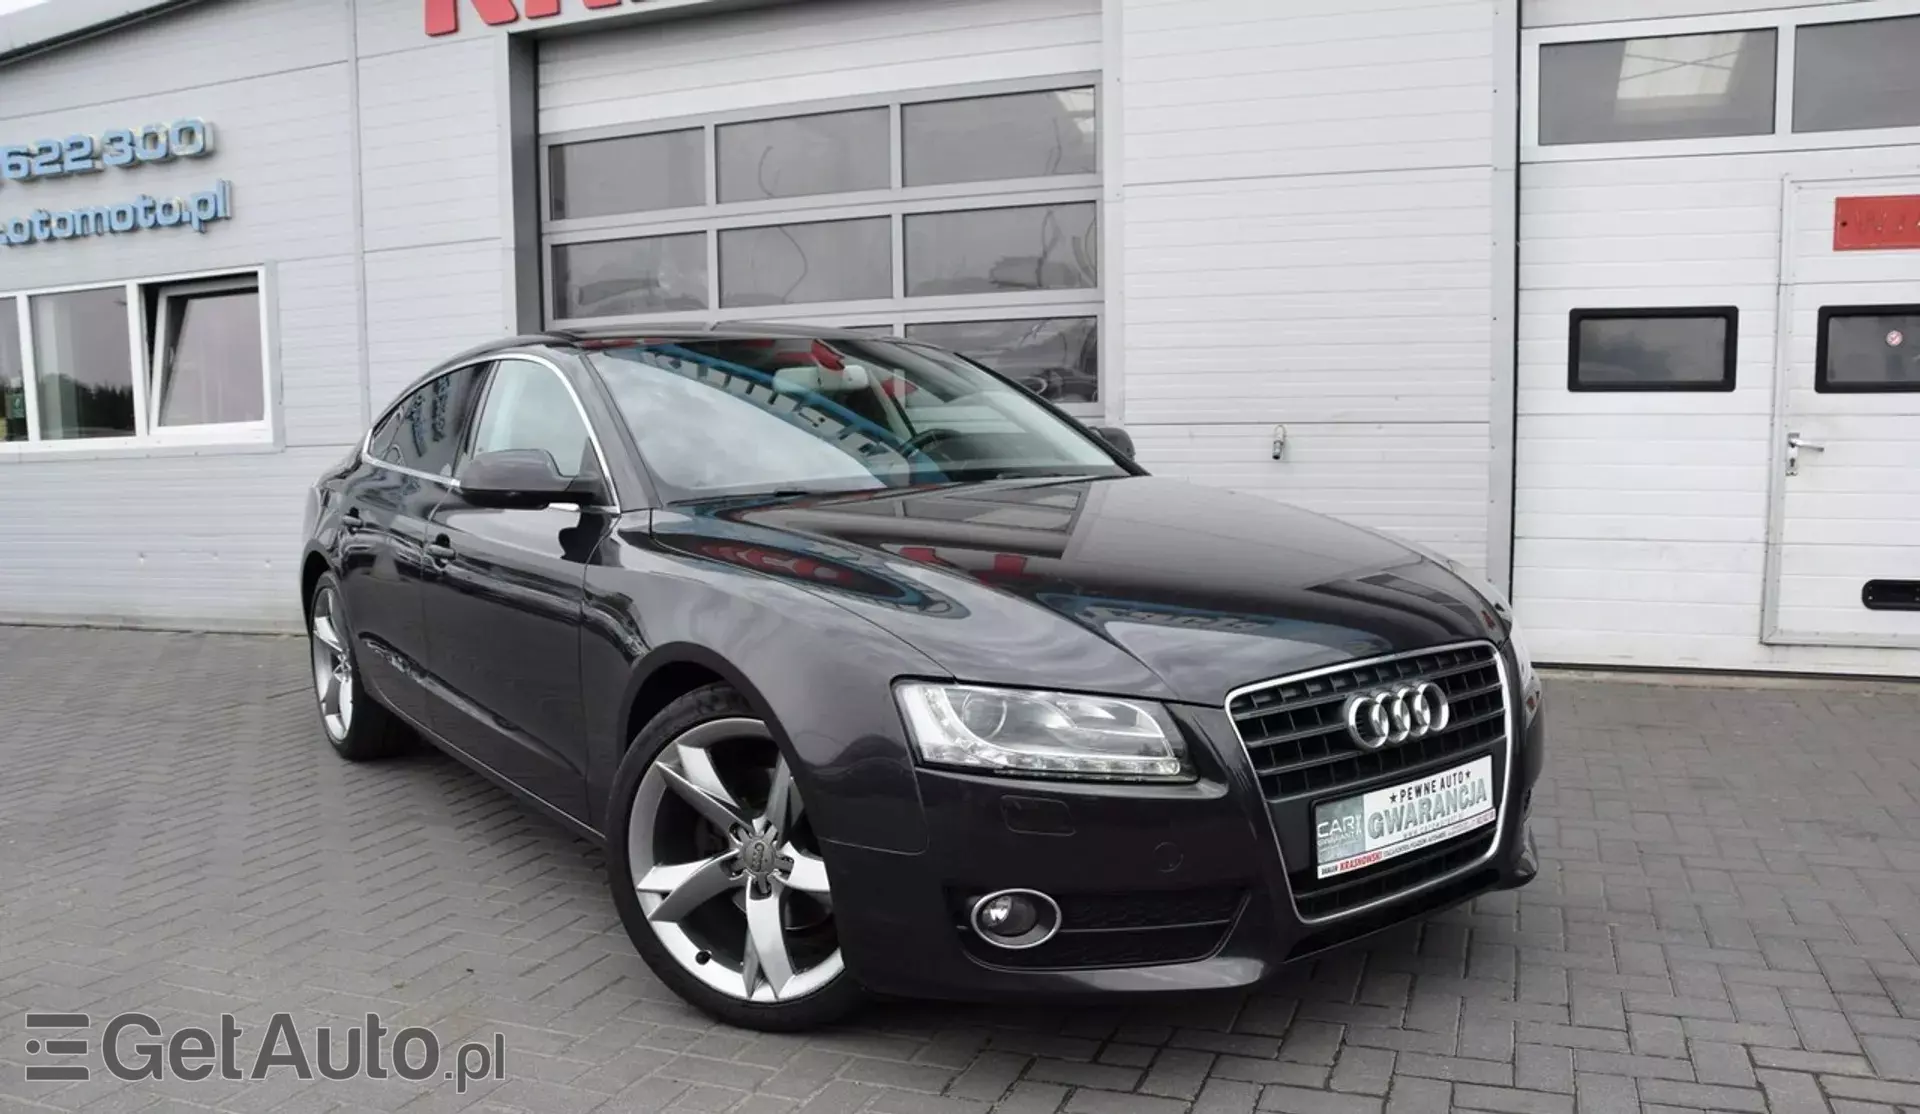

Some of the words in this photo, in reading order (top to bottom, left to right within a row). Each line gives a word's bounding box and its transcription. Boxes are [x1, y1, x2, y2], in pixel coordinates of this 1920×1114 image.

[0, 134, 97, 179] 622
[102, 116, 212, 166] 300
[1367, 778, 1488, 840] GWARANCJA
[1400, 780, 1437, 803] PEWNE
[1440, 771, 1464, 791] AUTO
